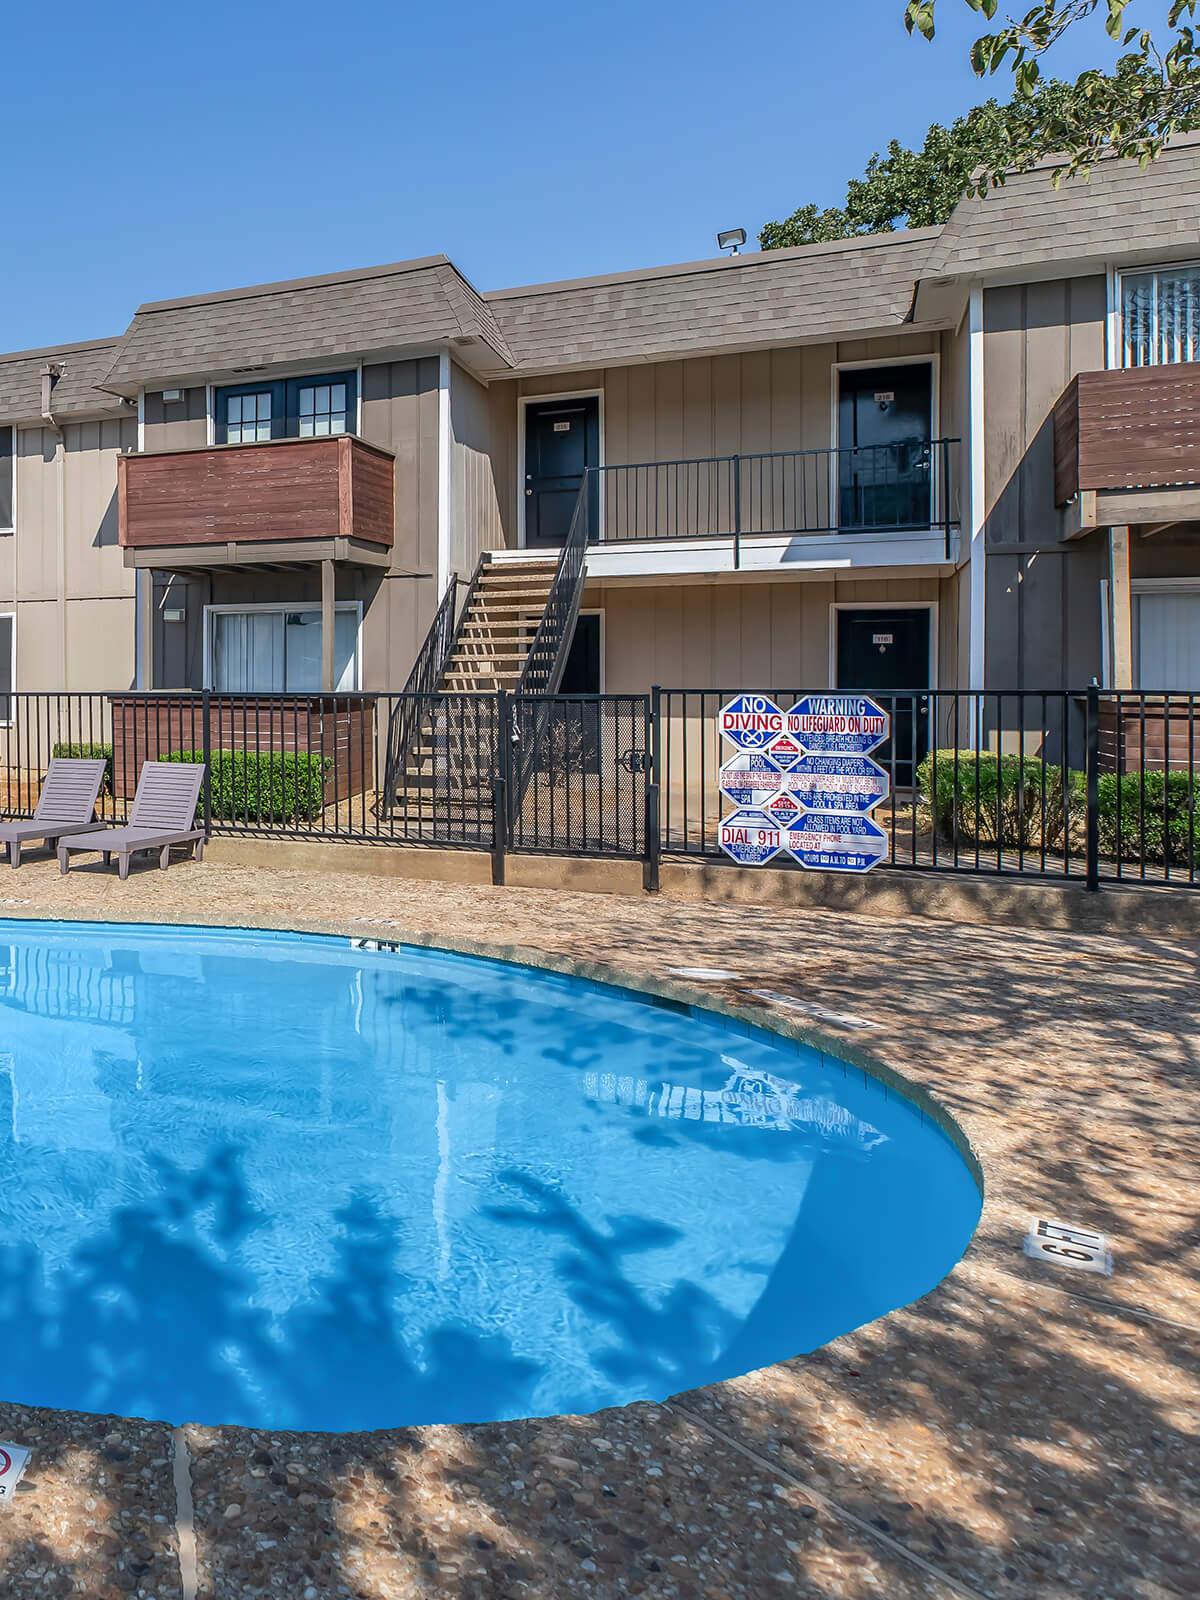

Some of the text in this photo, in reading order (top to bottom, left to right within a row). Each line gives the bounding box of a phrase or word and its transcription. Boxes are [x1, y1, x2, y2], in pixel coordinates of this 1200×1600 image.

[742, 697, 766, 713] NO
[808, 699, 866, 715] WARNING
[723, 714, 782, 730] DIVING
[787, 716, 885, 733] NO LIFEGUARD ON DUTY
[800, 734, 825, 743] EXTENDED
[826, 735, 844, 743] BREATH
[845, 735, 866, 744] HOLDING
[751, 760, 766, 768] POOL
[807, 757, 864, 767] NO CHANGING DIAPERS
[817, 765, 828, 773] FEET
[836, 766, 845, 774] THE
[845, 767, 858, 775] POOL
[741, 794, 751, 802] SPA
[800, 792, 812, 800] PETS
[813, 792, 822, 801] ARE
[823, 793, 855, 802] PROHIBITED
[813, 800, 826, 808] POOL
[834, 801, 844, 809] SPA
[845, 801, 859, 809] AREA
[807, 815, 863, 826] GLASS ITEMS ARE NOT
[803, 823, 829, 832] ALLOWED
[837, 825, 851, 833] POOL
[852, 826, 866, 834] YARD
[722, 828, 780, 846] DIAL 911
[790, 832, 841, 842] EMERGENCY PHONE
[732, 844, 769, 855] EMERGENCY
[789, 841, 813, 849] LOCATED
[804, 854, 819, 863] HOURS
[378, 941, 399, 952] FT
[1037, 1220, 1099, 1261] 6 FT
